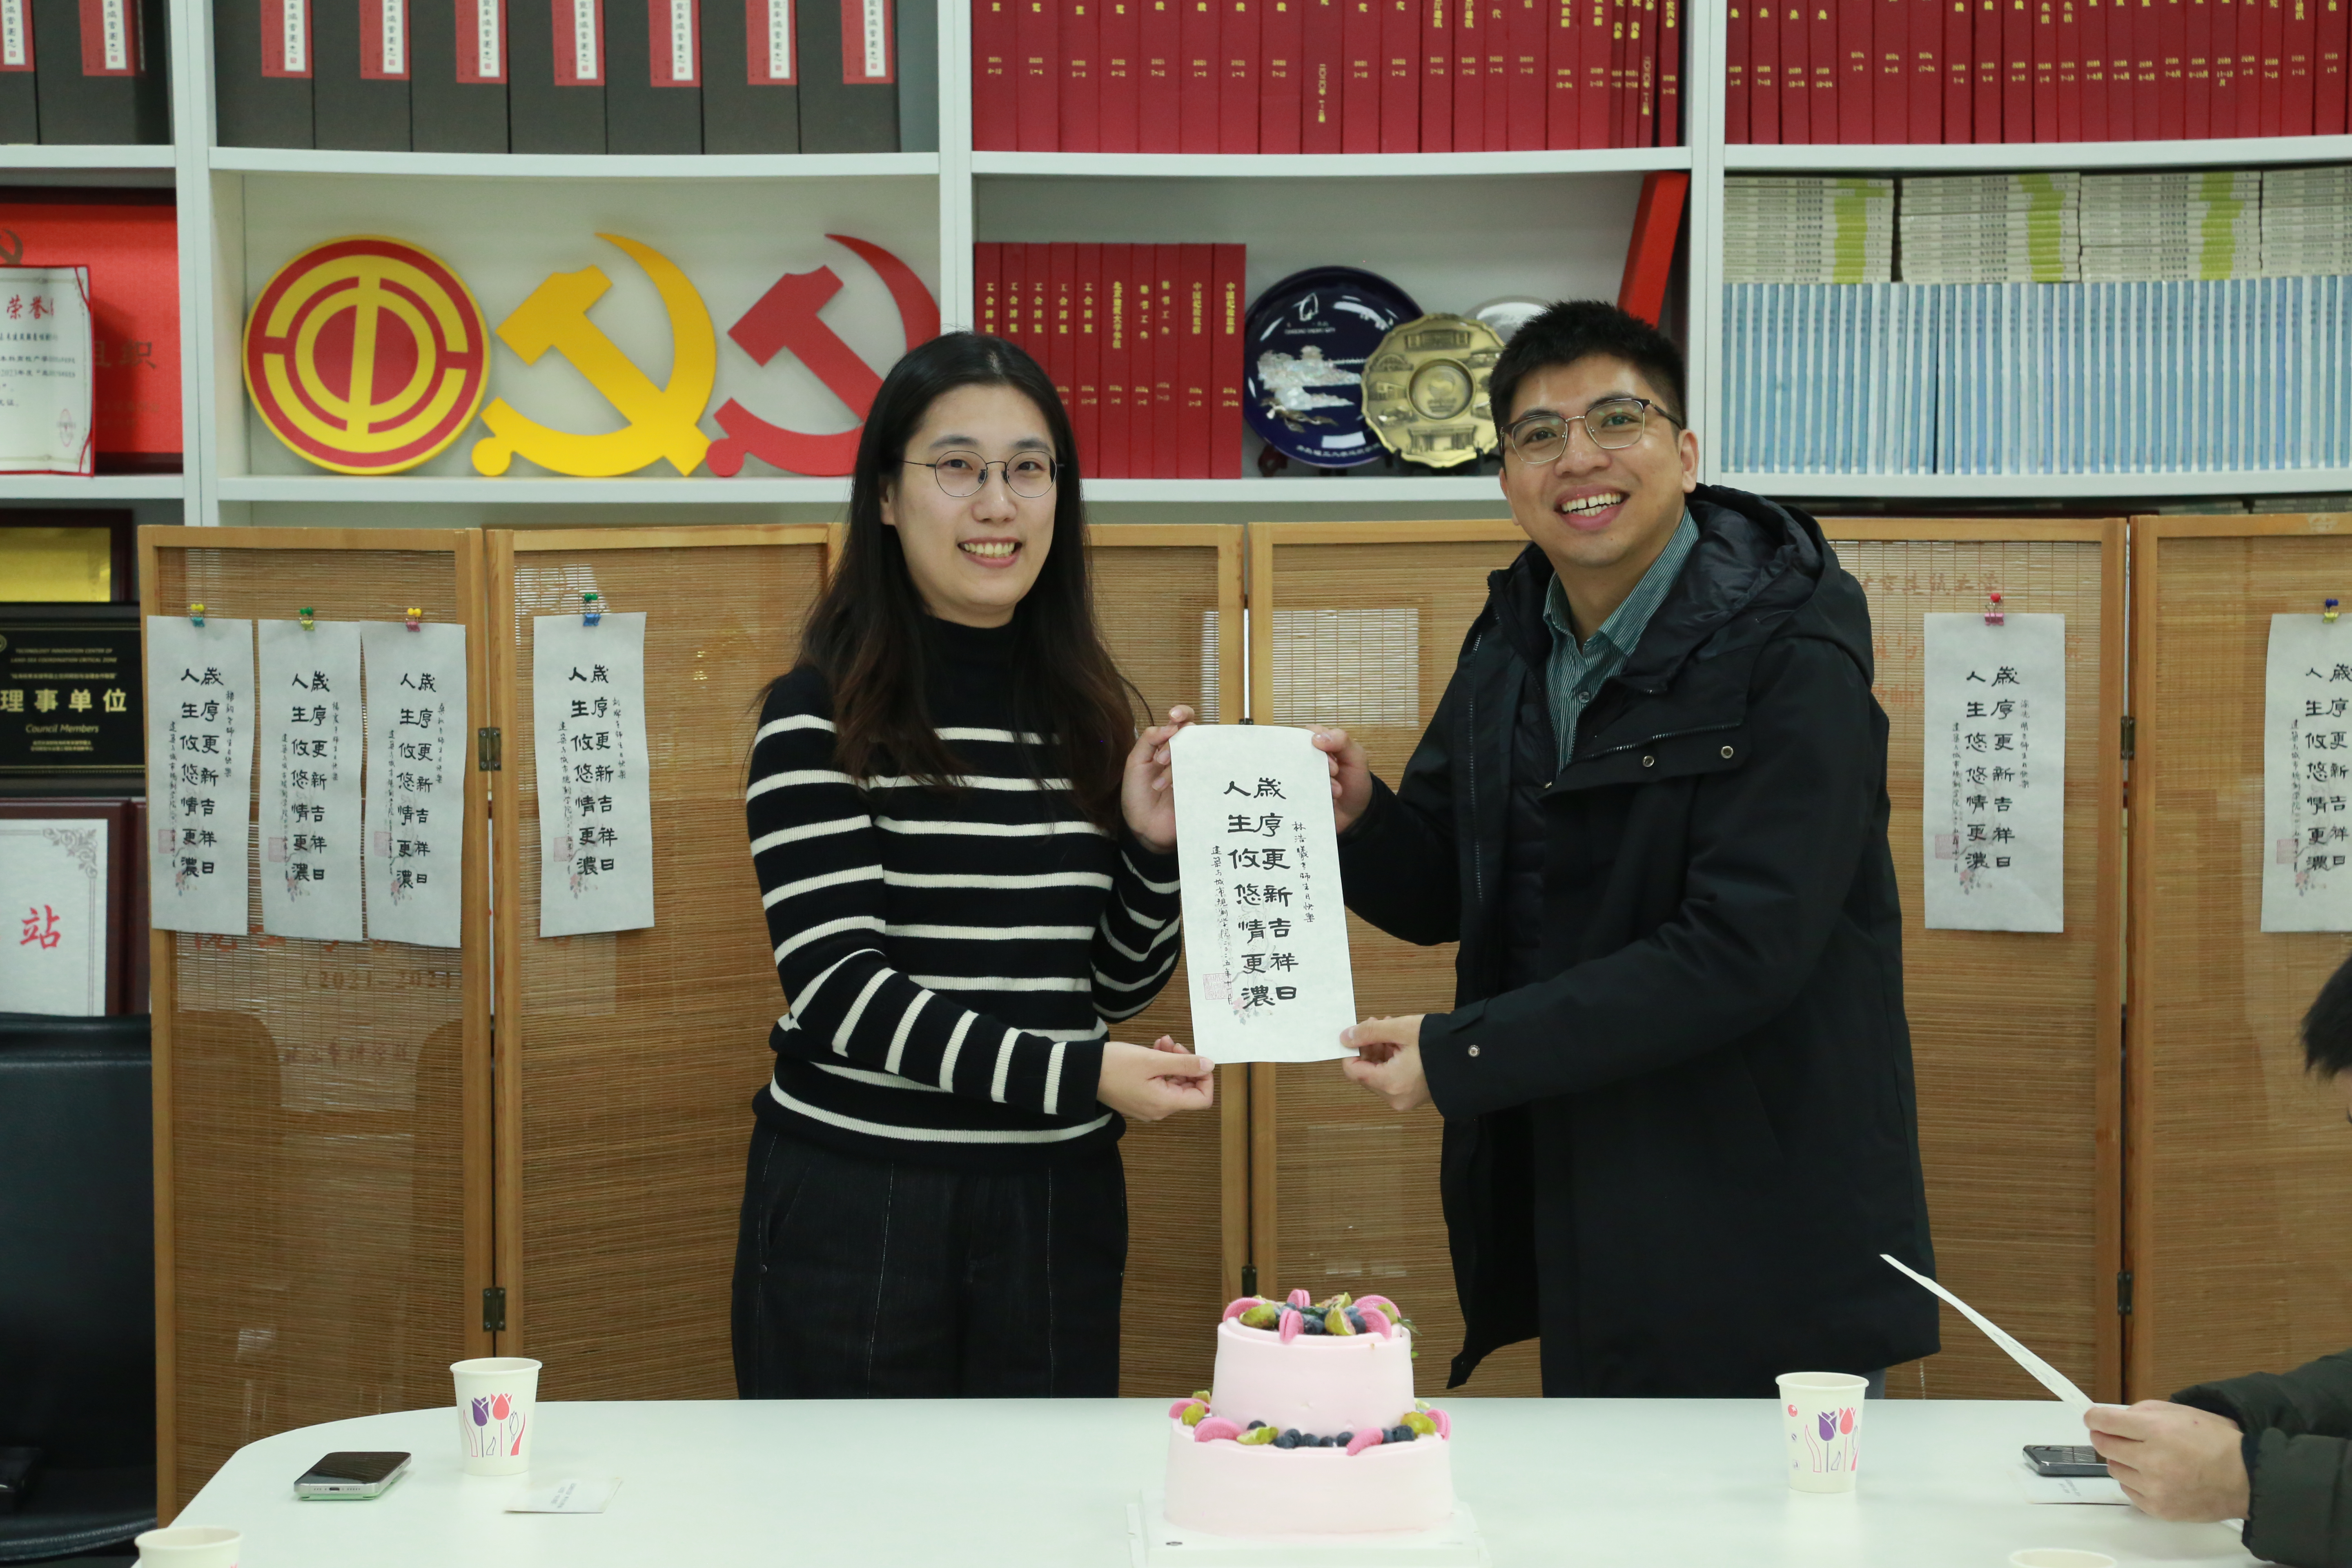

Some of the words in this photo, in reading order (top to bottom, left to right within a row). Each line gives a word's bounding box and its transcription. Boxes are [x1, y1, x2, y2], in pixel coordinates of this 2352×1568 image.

[6, 294, 54, 320] 荣誉
[0, 688, 127, 713] 理事单位
[25, 723, 58, 733] Council
[60, 724, 99, 734] Members
[20, 904, 61, 950] 站
